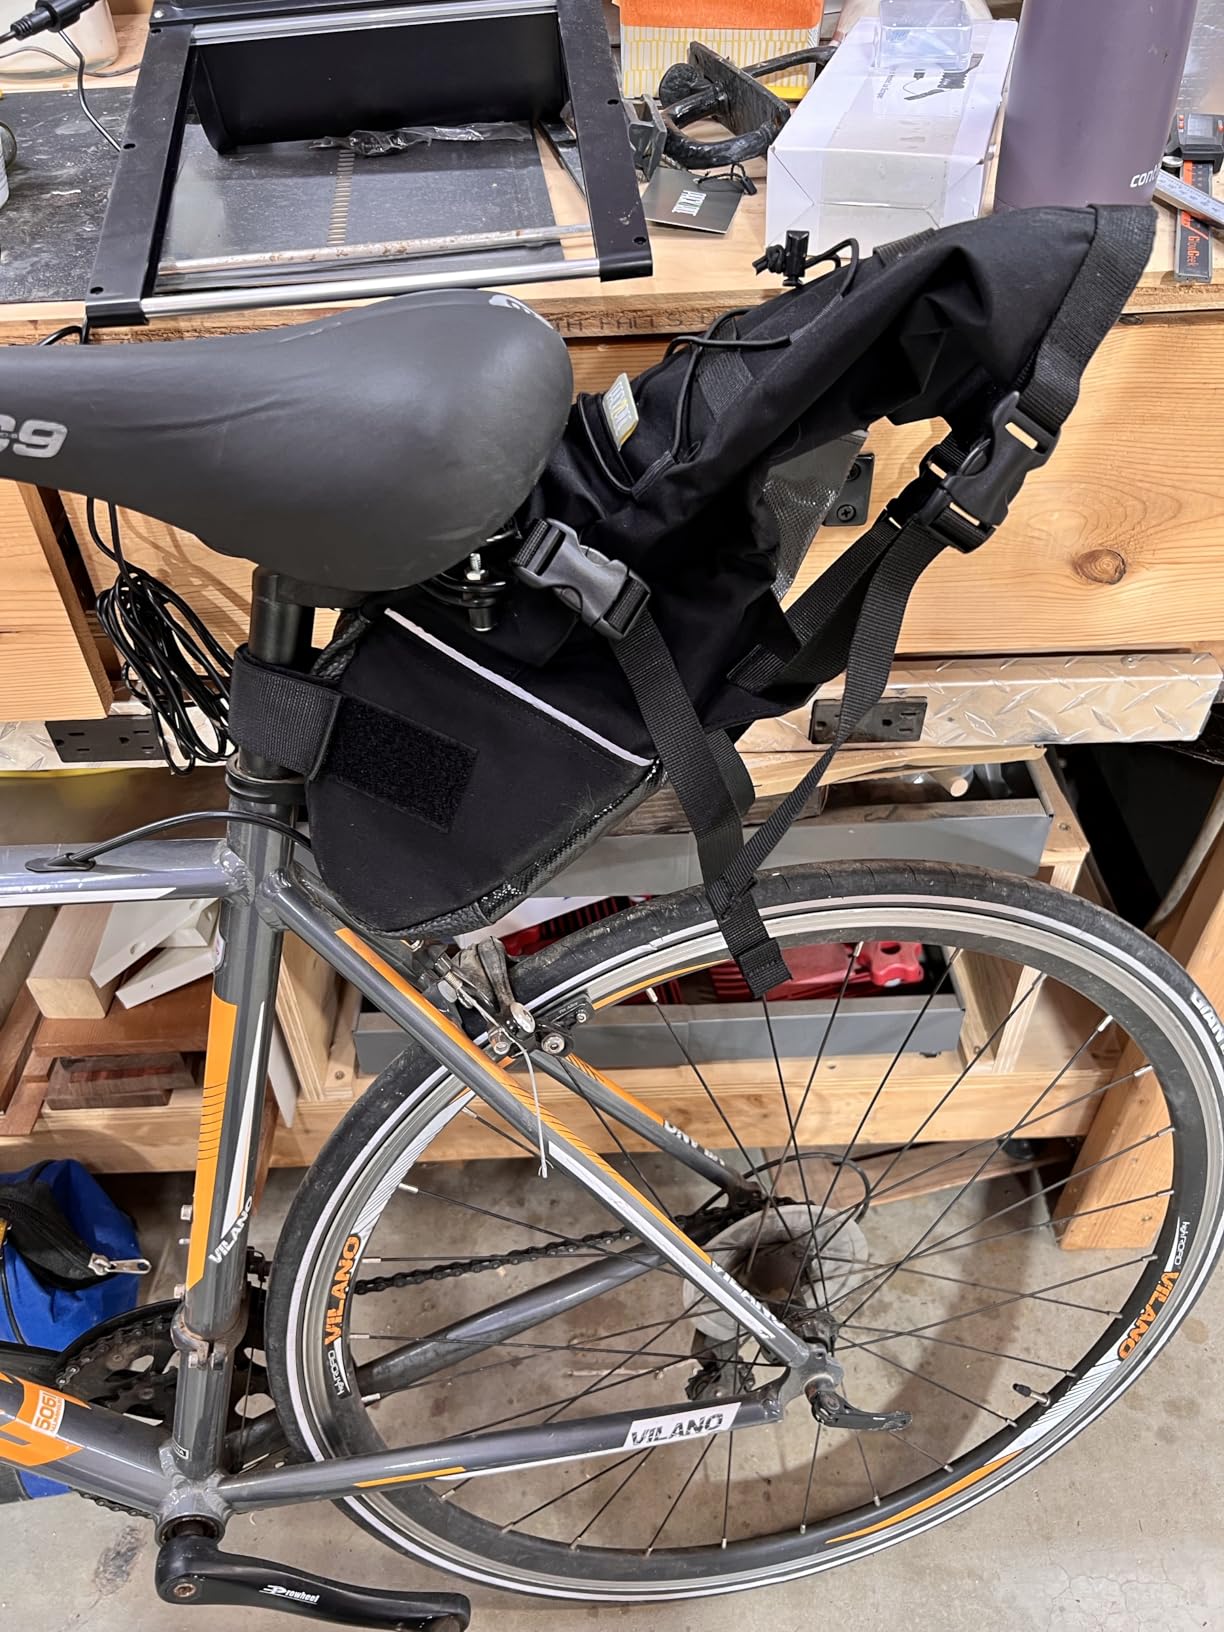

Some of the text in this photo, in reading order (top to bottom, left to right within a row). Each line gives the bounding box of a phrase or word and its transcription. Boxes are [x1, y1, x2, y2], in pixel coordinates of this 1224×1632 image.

[208, 1195, 253, 1264] VILANO
[324, 1235, 360, 1345] VILANO
[1117, 1271, 1180, 1360] VILANO
[631, 1413, 724, 1446] VILANO
[259, 1584, 320, 1604] Prowheel
